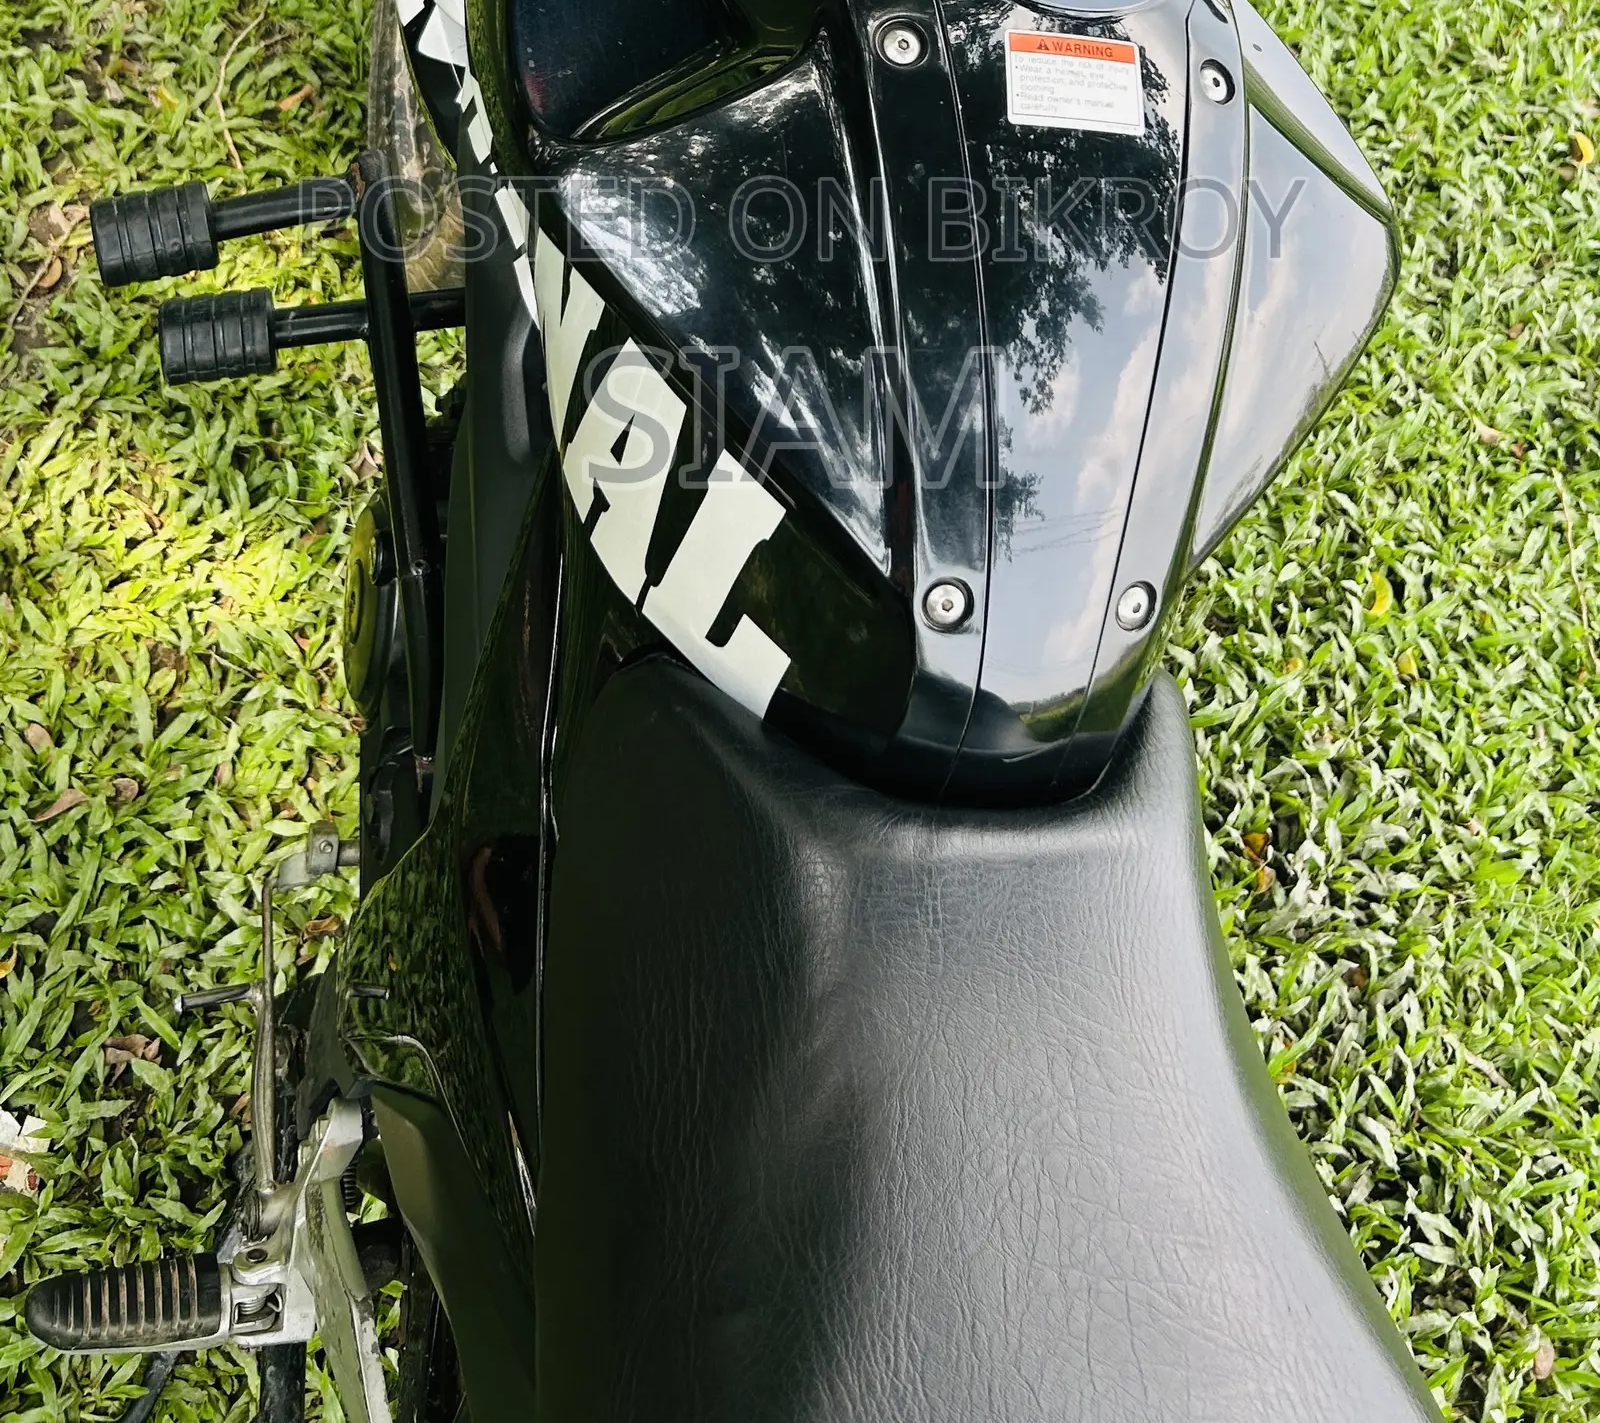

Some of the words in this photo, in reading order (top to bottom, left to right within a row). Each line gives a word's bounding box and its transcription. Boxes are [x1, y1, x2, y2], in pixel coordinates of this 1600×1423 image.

[1051, 41, 1114, 58] WARNING
[1014, 54, 1025, 64] To
[1028, 56, 1057, 65] reduce
[1061, 59, 1075, 68] the
[1078, 60, 1092, 69] risk
[1096, 62, 1104, 71] of
[1020, 65, 1042, 74] Wear
[1069, 78, 1085, 87] and
[1087, 81, 1128, 92] protective
[1020, 92, 1044, 102] Read
[1084, 99, 1115, 109] manual
